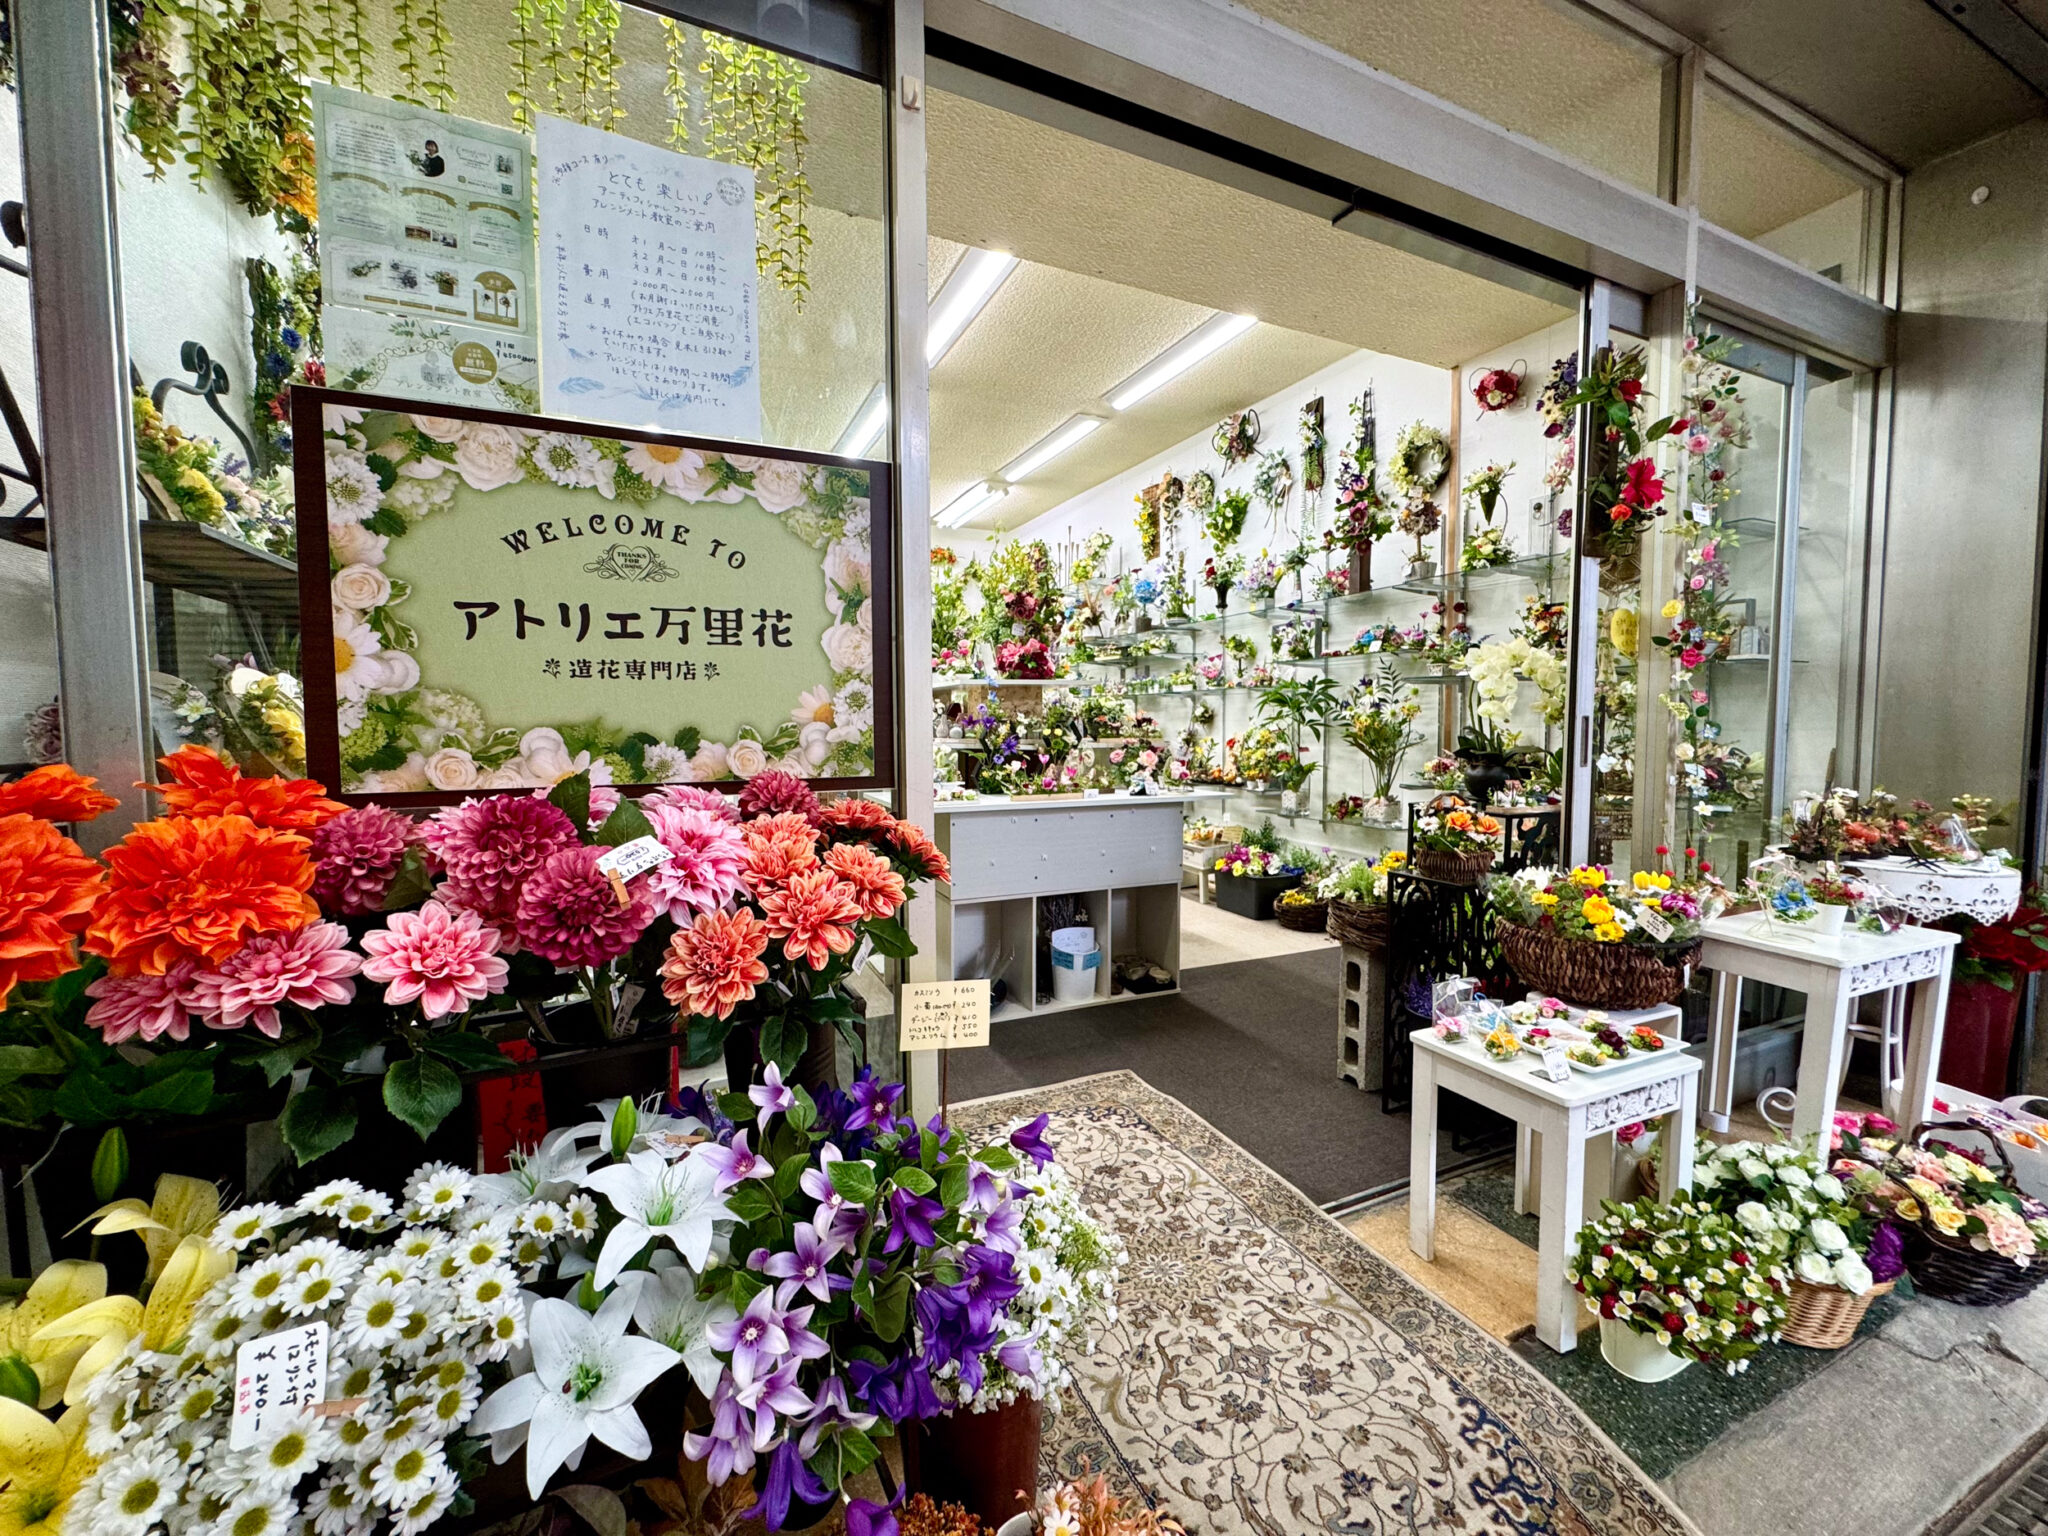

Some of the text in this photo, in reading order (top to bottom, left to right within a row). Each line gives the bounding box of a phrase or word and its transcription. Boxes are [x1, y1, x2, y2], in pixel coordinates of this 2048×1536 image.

[500, 514, 746, 569] WELCOME TO
[617, 551, 647, 559] THANKS
[453, 598, 794, 649] アトリエ万里花
[568, 658, 697, 682] 造花専門店
